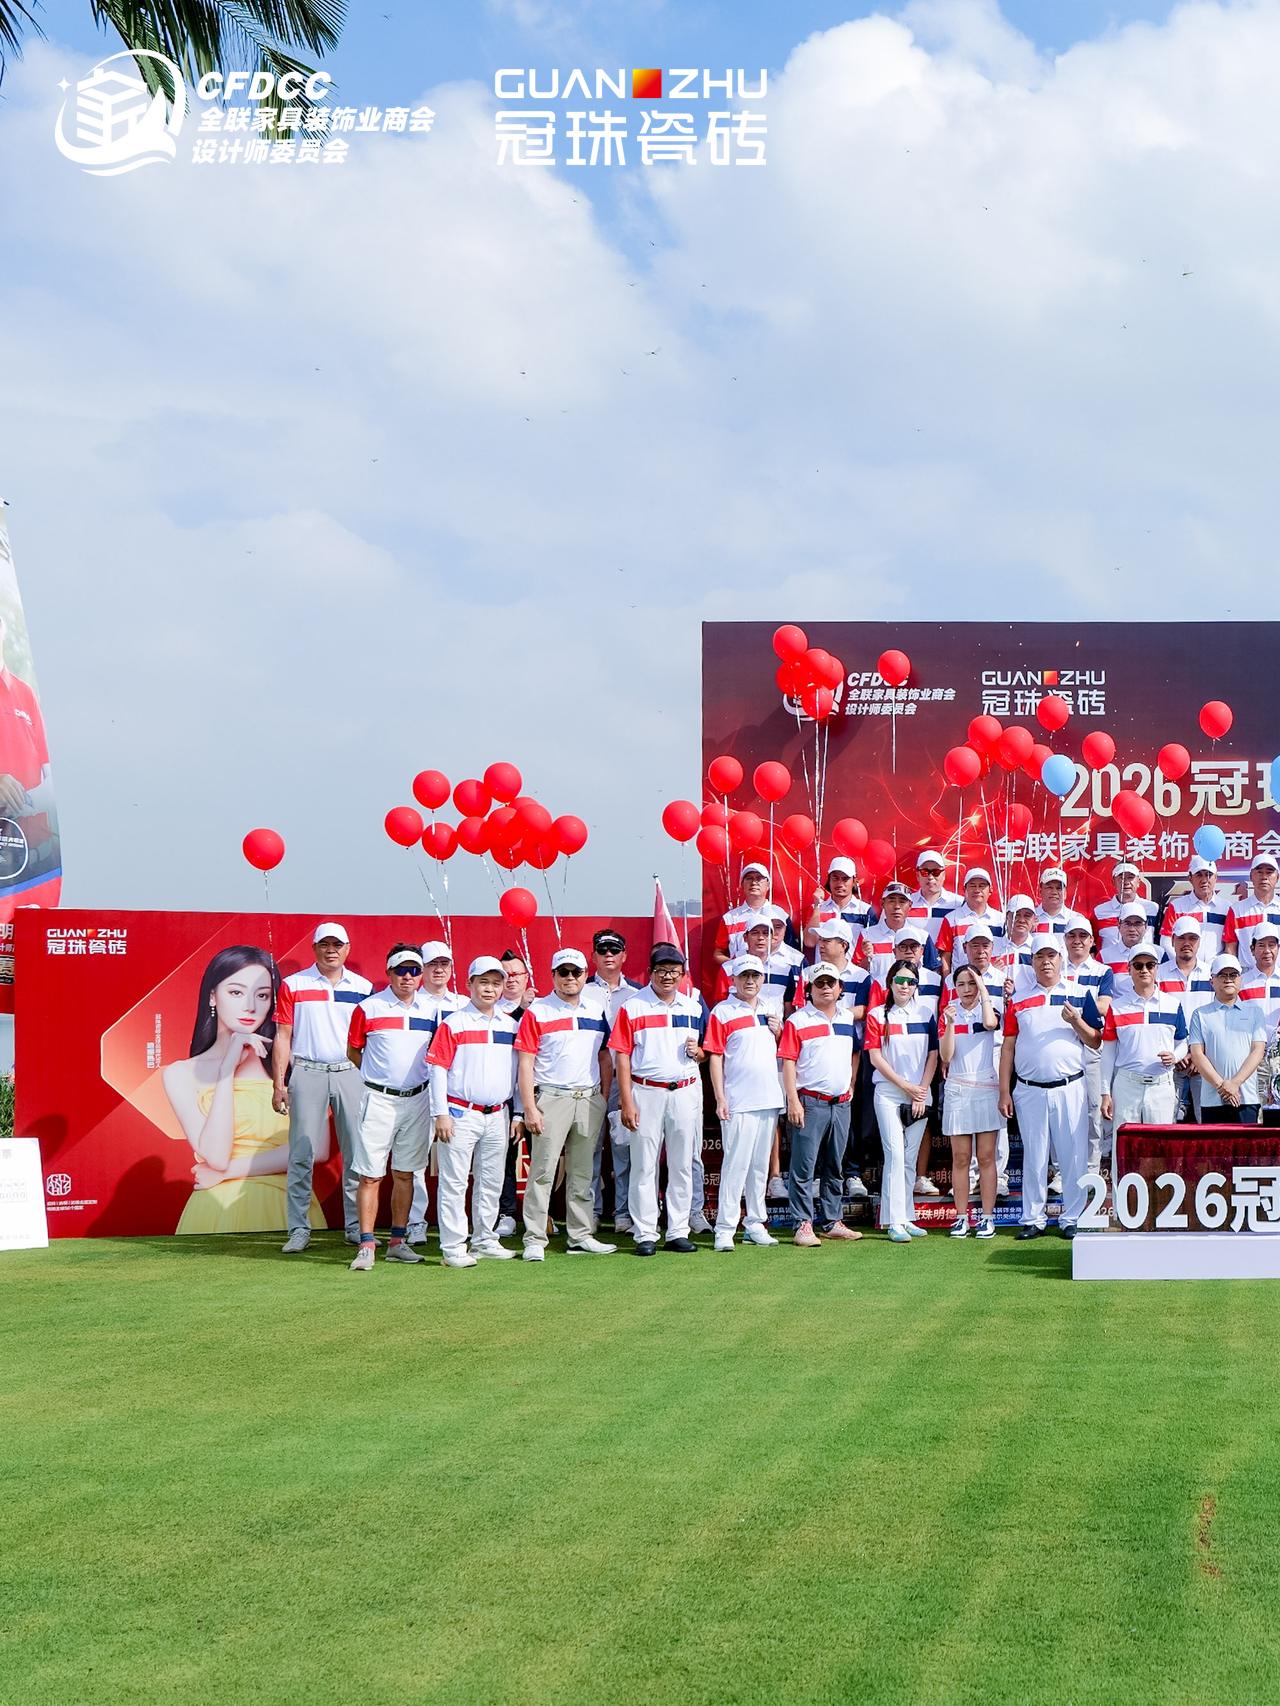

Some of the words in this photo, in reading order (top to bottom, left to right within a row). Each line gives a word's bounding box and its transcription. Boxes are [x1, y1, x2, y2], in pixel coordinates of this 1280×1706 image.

[847, 672, 908, 686] CFD
[848, 688, 956, 700] 全联家具装饰业商会
[845, 703, 918, 715] 设计师委员会
[47, 939, 127, 955] 冠珠瓷砖
